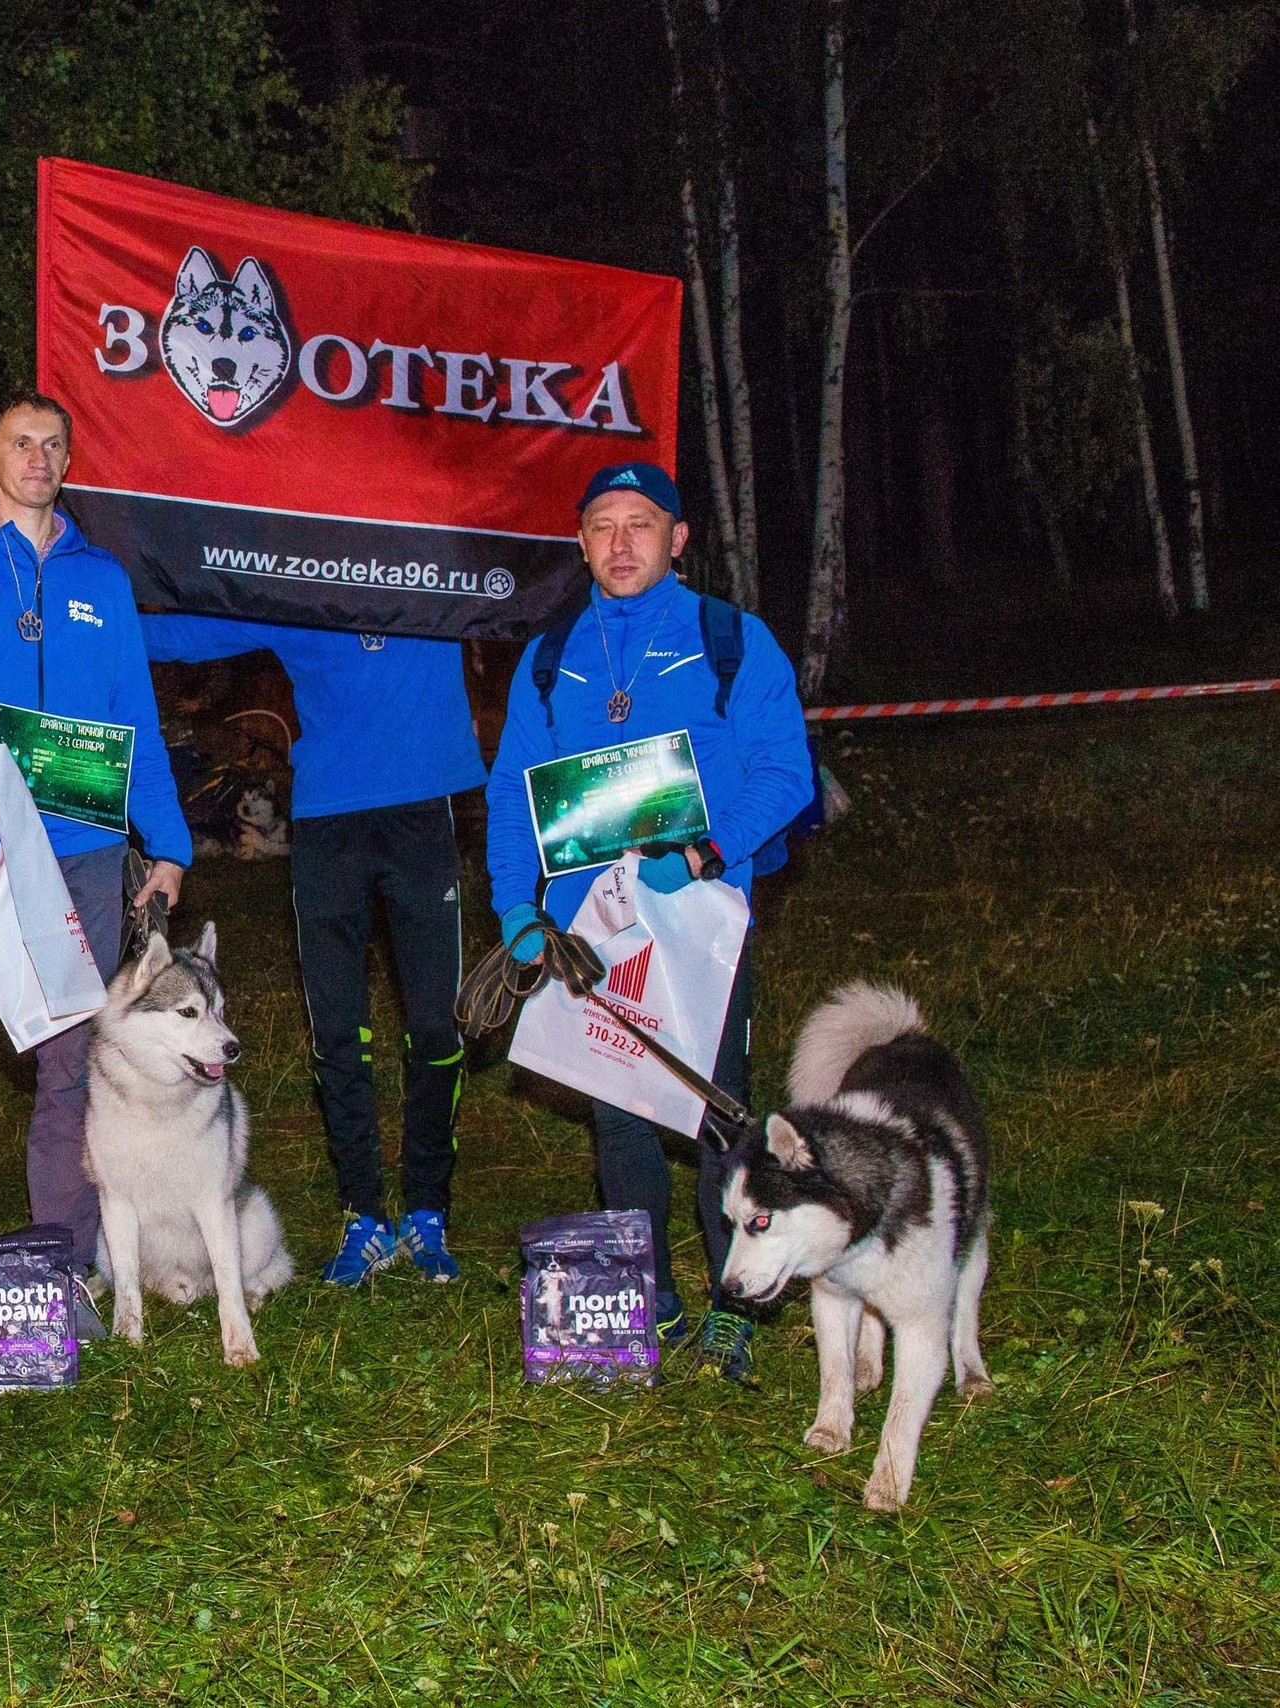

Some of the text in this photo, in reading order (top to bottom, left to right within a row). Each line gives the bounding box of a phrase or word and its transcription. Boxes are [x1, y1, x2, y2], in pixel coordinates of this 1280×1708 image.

[609, 478, 641, 487] adidas
[203, 543, 478, 595] www.zooteka96.ru
[40, 718, 73, 734] ДРАЙЛЕНД
[106, 729, 127, 742] СЛЕД"
[58, 736, 105, 753] 2-3 СЕНТЯБРЯ
[582, 751, 622, 770] ДРАЙЛЕНД
[607, 766, 622, 779] 2-3
[582, 1007, 611, 1024] АГЕНТСТВО
[585, 1022, 646, 1059] 310-22-22
[569, 1289, 645, 1312] north
[575, 1312, 630, 1335] paw
